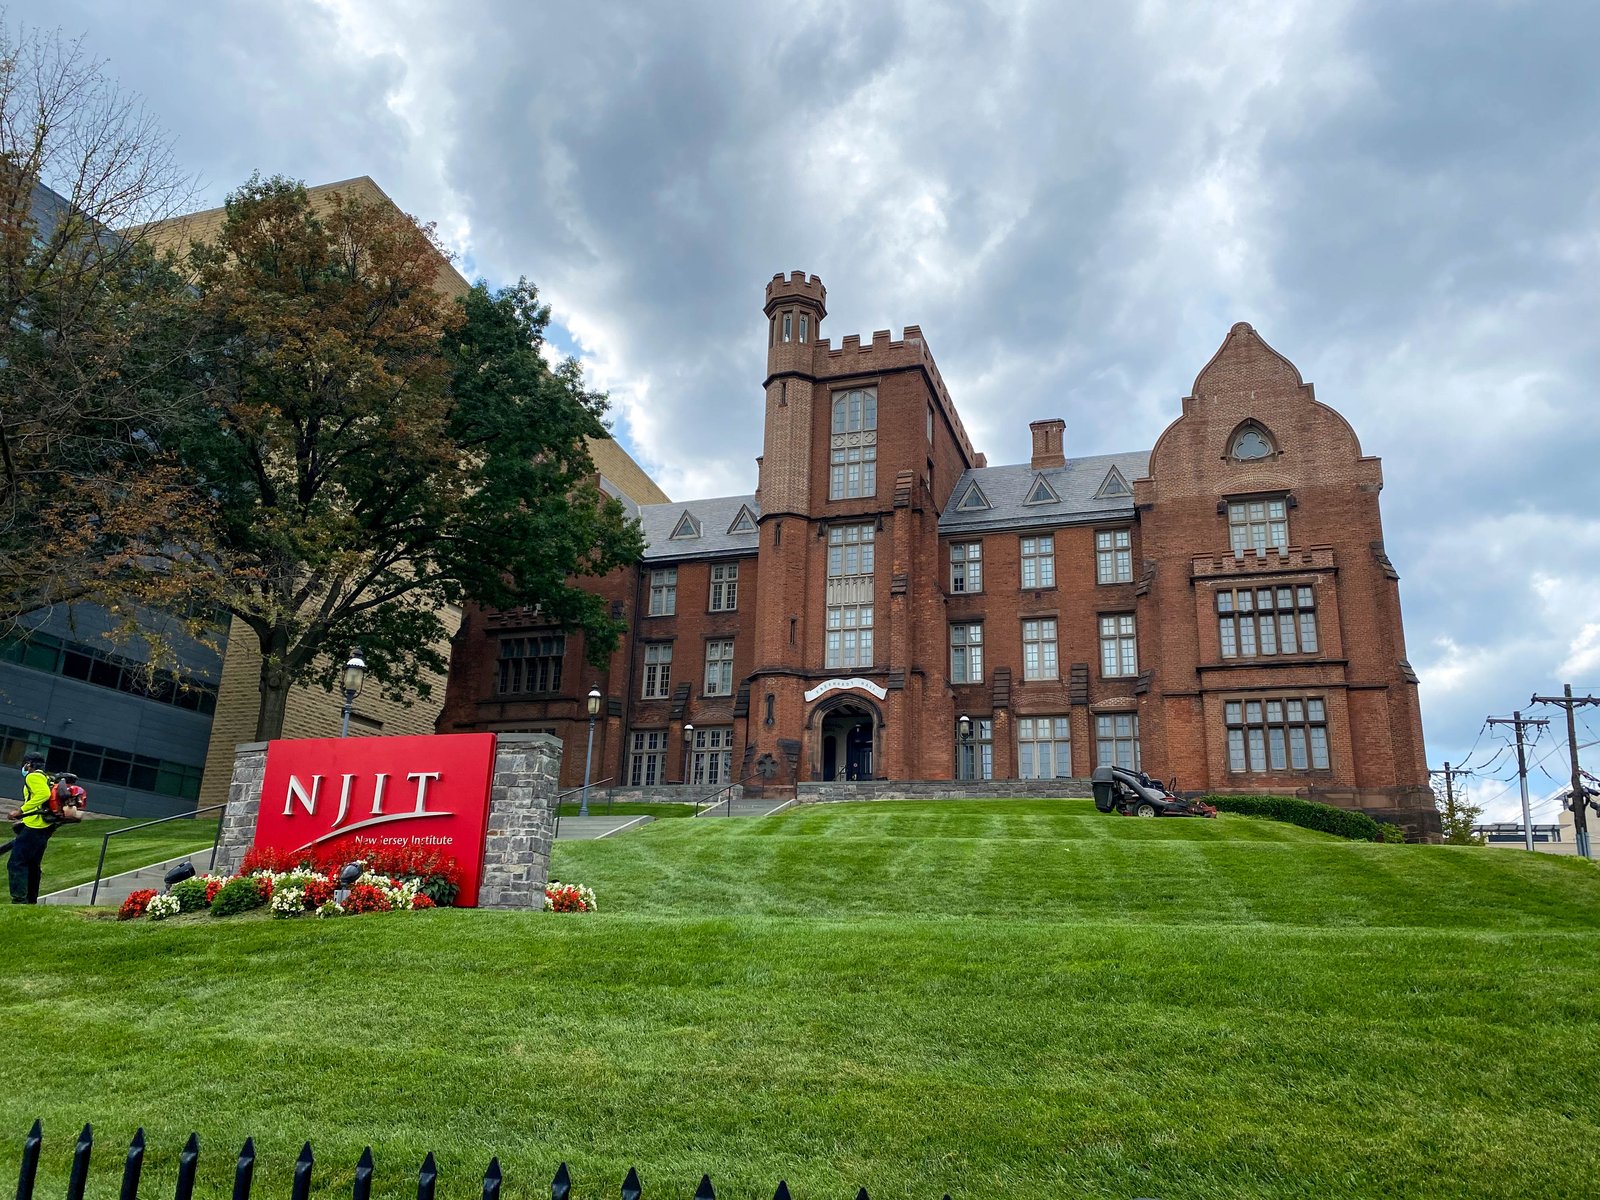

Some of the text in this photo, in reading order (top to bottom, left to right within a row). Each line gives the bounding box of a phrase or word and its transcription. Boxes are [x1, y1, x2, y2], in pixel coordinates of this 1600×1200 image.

[282, 771, 441, 827] NJIT
[355, 835, 377, 845] New
[411, 835, 453, 845] Institute
